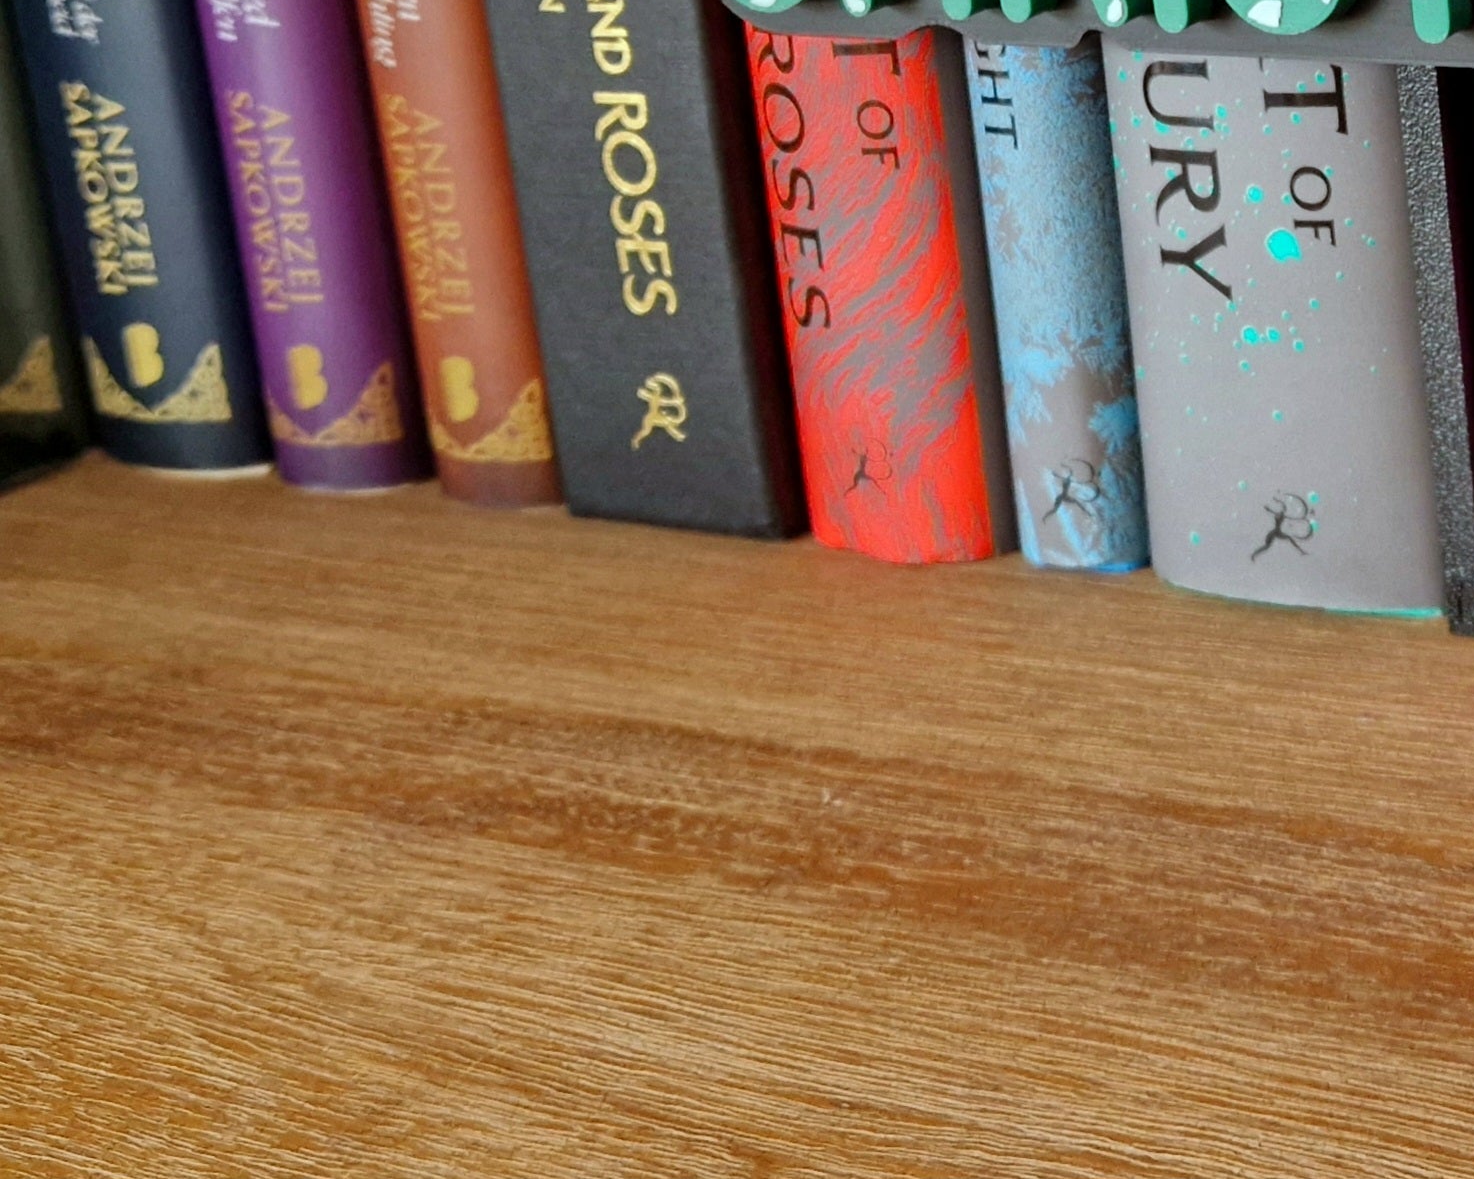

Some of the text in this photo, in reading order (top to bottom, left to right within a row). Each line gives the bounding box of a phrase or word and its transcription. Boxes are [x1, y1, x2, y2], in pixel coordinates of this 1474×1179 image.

[60, 78, 128, 296] SAPKOWSKI
[90, 92, 160, 290] ANDRZEJ
[227, 89, 290, 315] SAPKOWSKI
[256, 103, 325, 310] ANDRZEJ
[382, 92, 433, 322] SAPKOWSKI
[411, 108, 477, 317] ANDRZEJ
[592, 90, 678, 317] ROSES
[757, 32, 832, 330] ROSES
[856, 99, 900, 171] OF
[1289, 165, 1337, 248] OF
